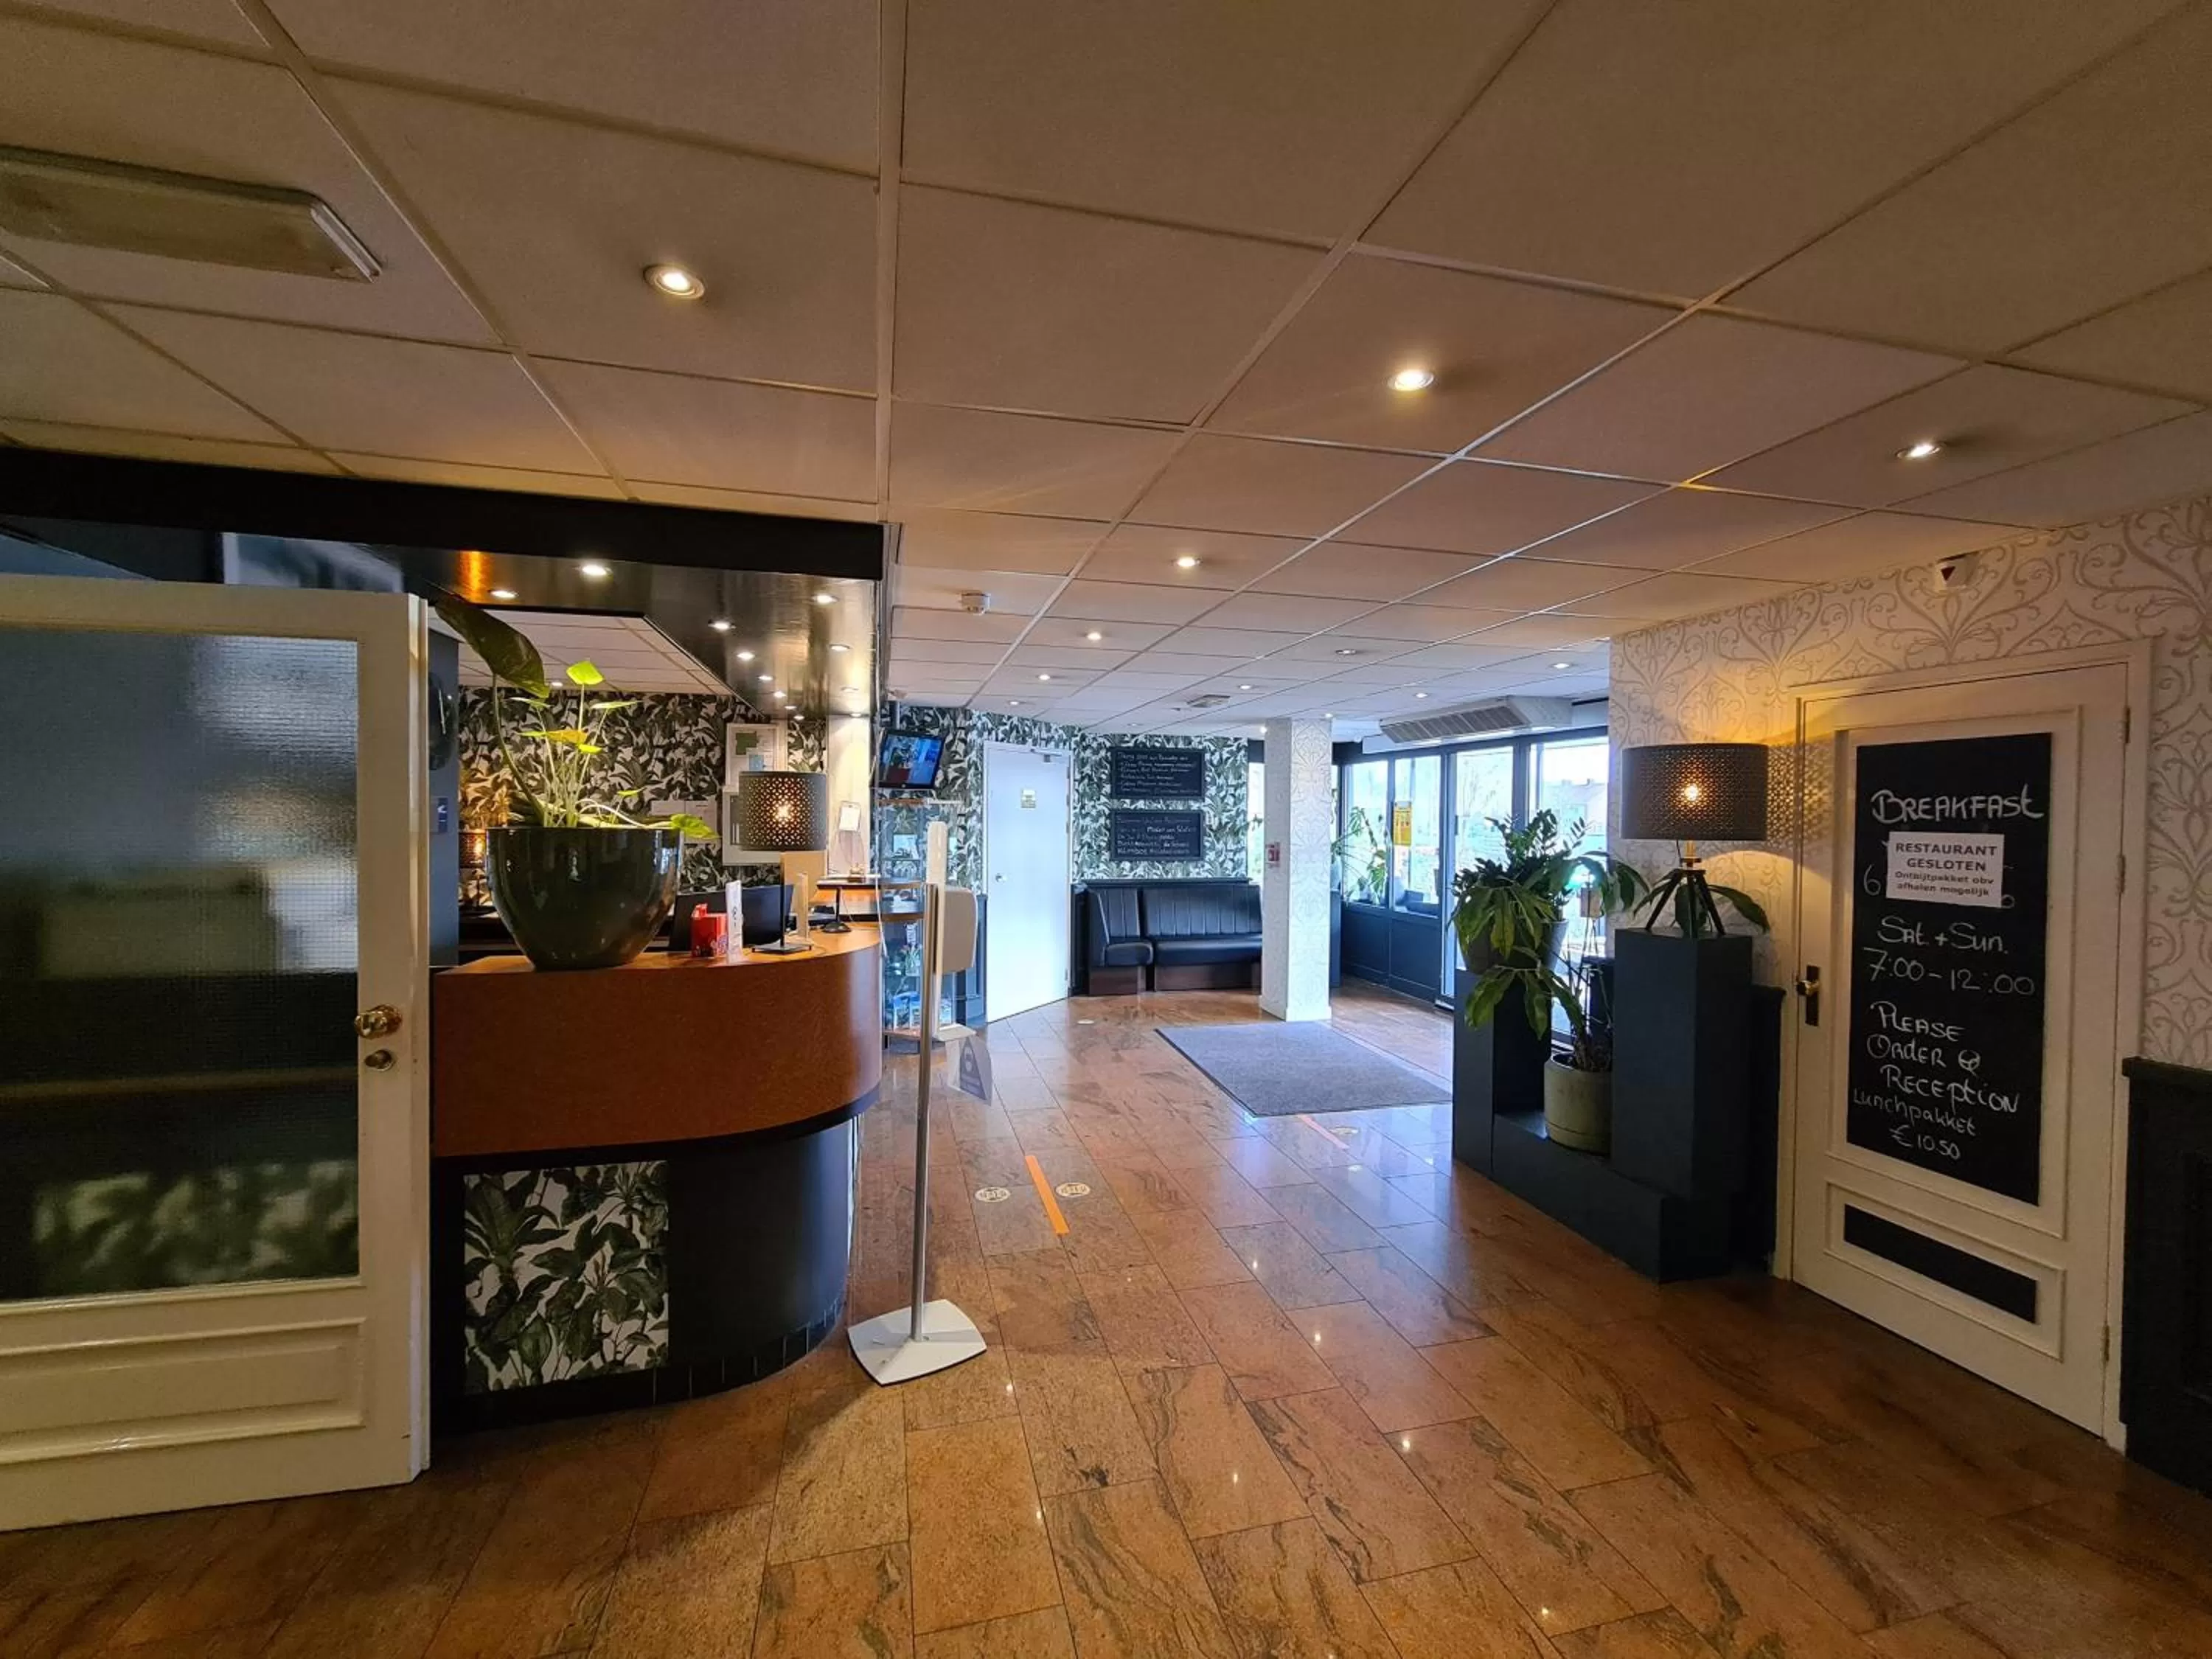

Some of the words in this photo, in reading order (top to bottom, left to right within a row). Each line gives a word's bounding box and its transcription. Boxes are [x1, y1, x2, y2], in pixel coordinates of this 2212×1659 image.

[1895, 842, 1997, 856] RESTAURANT
[1907, 858, 1986, 872] GESLOTEN
[1896, 882, 1937, 892] afhalen
[1940, 886, 1989, 897] mogelijk
